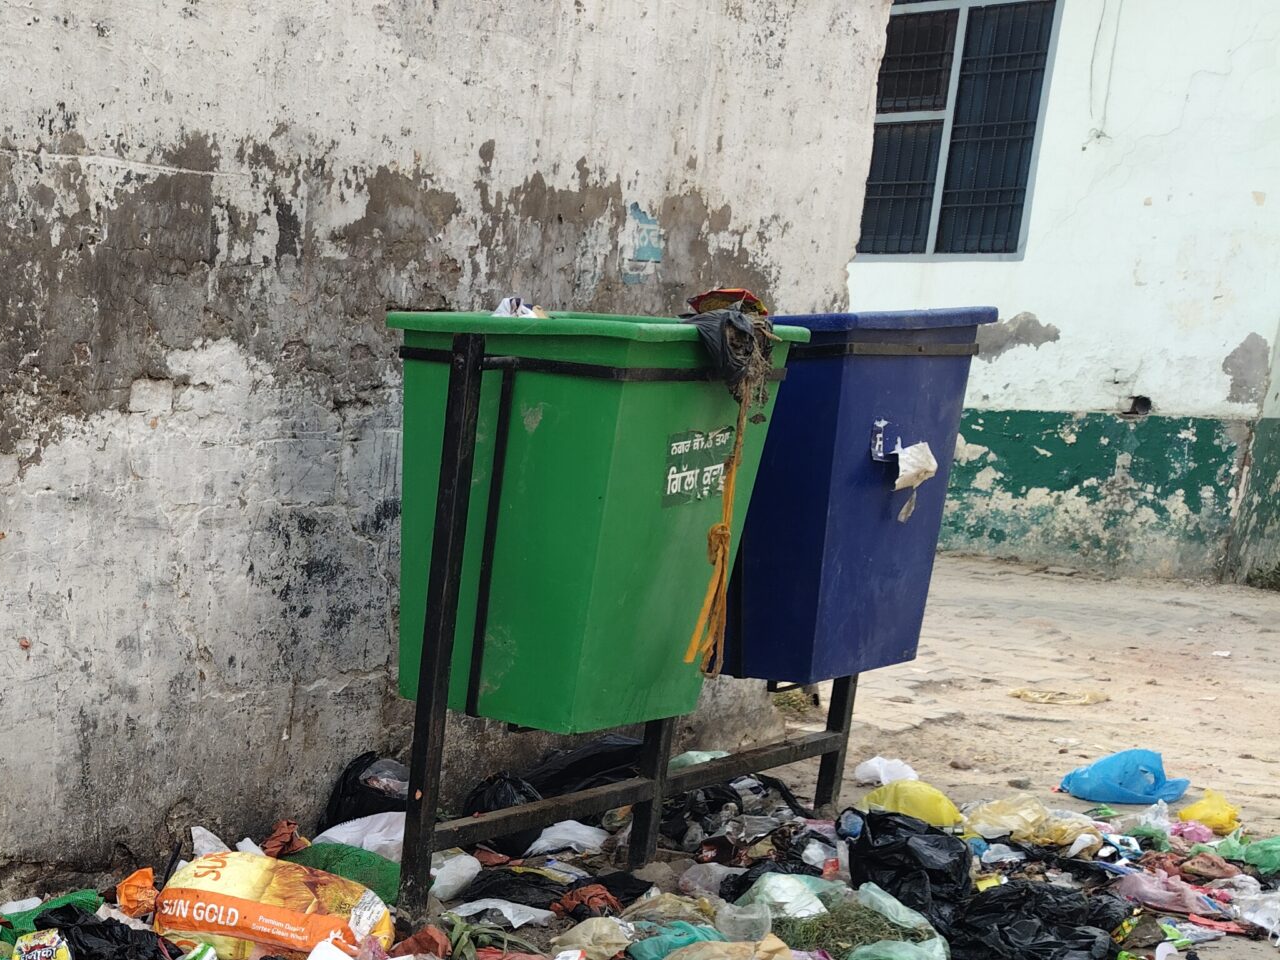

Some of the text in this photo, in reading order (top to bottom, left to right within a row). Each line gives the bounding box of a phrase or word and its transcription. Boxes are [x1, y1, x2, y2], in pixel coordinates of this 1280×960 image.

[667, 463, 700, 495] ਗਿੱਲਾ
[162, 898, 240, 928] SUN GOLD
